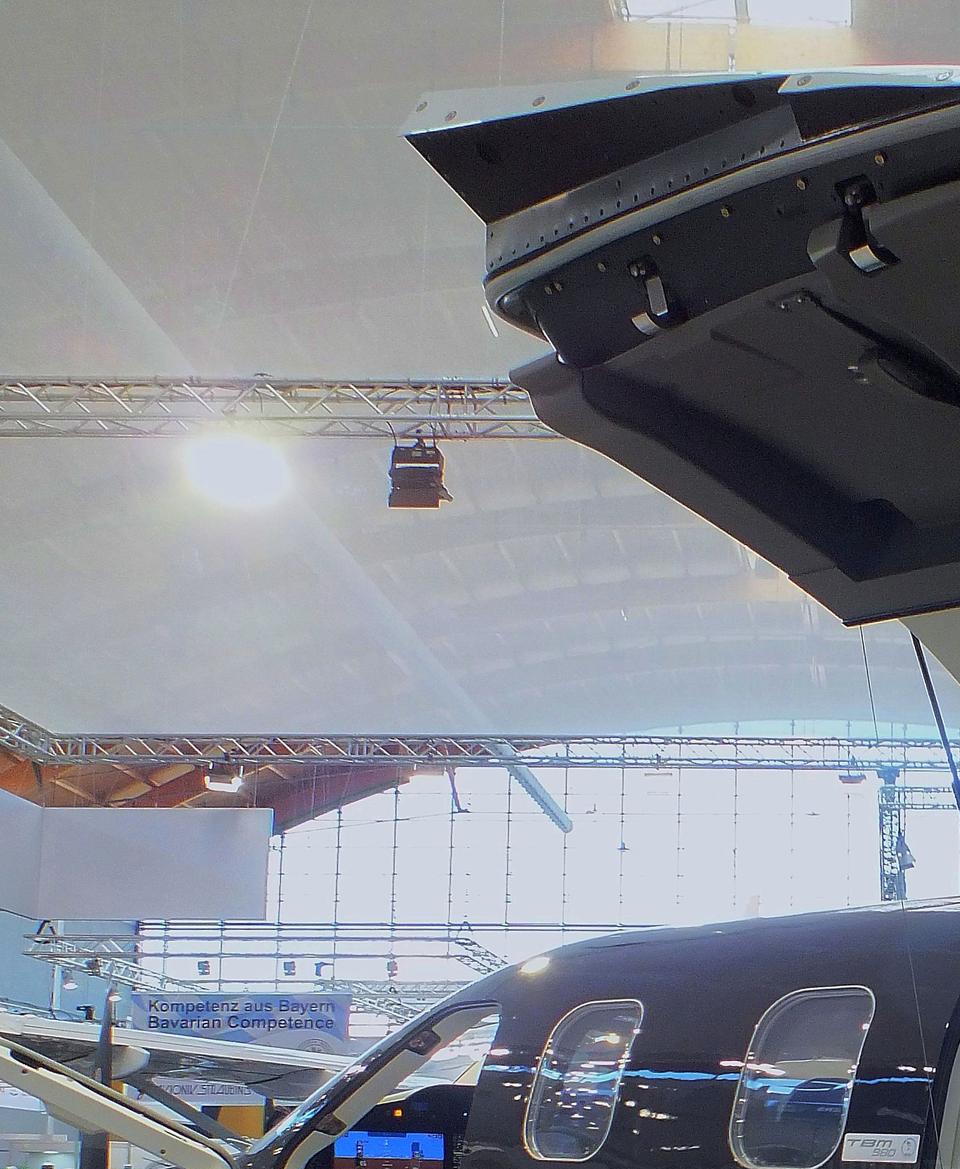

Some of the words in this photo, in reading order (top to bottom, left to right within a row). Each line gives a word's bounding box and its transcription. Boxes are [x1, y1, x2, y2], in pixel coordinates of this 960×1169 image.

[148, 1000, 240, 1014] Kompetenz
[245, 1001, 273, 1013] aus
[279, 999, 336, 1016] Bayern
[148, 1015, 221, 1029] Bavarian
[227, 1015, 335, 1031] Competence
